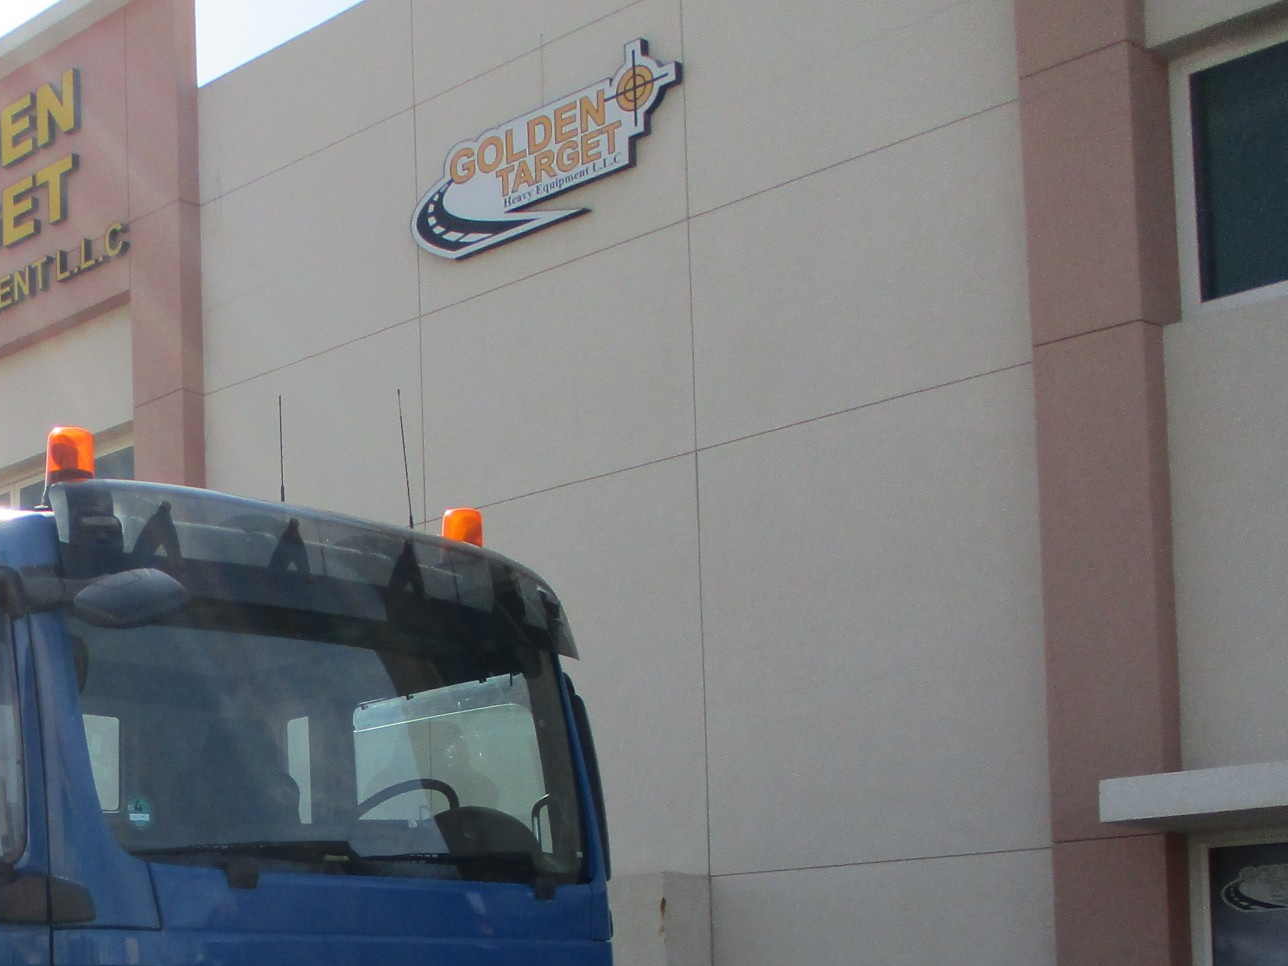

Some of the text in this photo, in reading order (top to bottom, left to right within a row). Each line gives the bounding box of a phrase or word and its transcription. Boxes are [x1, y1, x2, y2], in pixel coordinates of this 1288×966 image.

[450, 90, 605, 185] GOLDEN
[496, 120, 621, 197] TARGET
[504, 189, 533, 207] Heavy
[536, 167, 589, 194] Equipment
